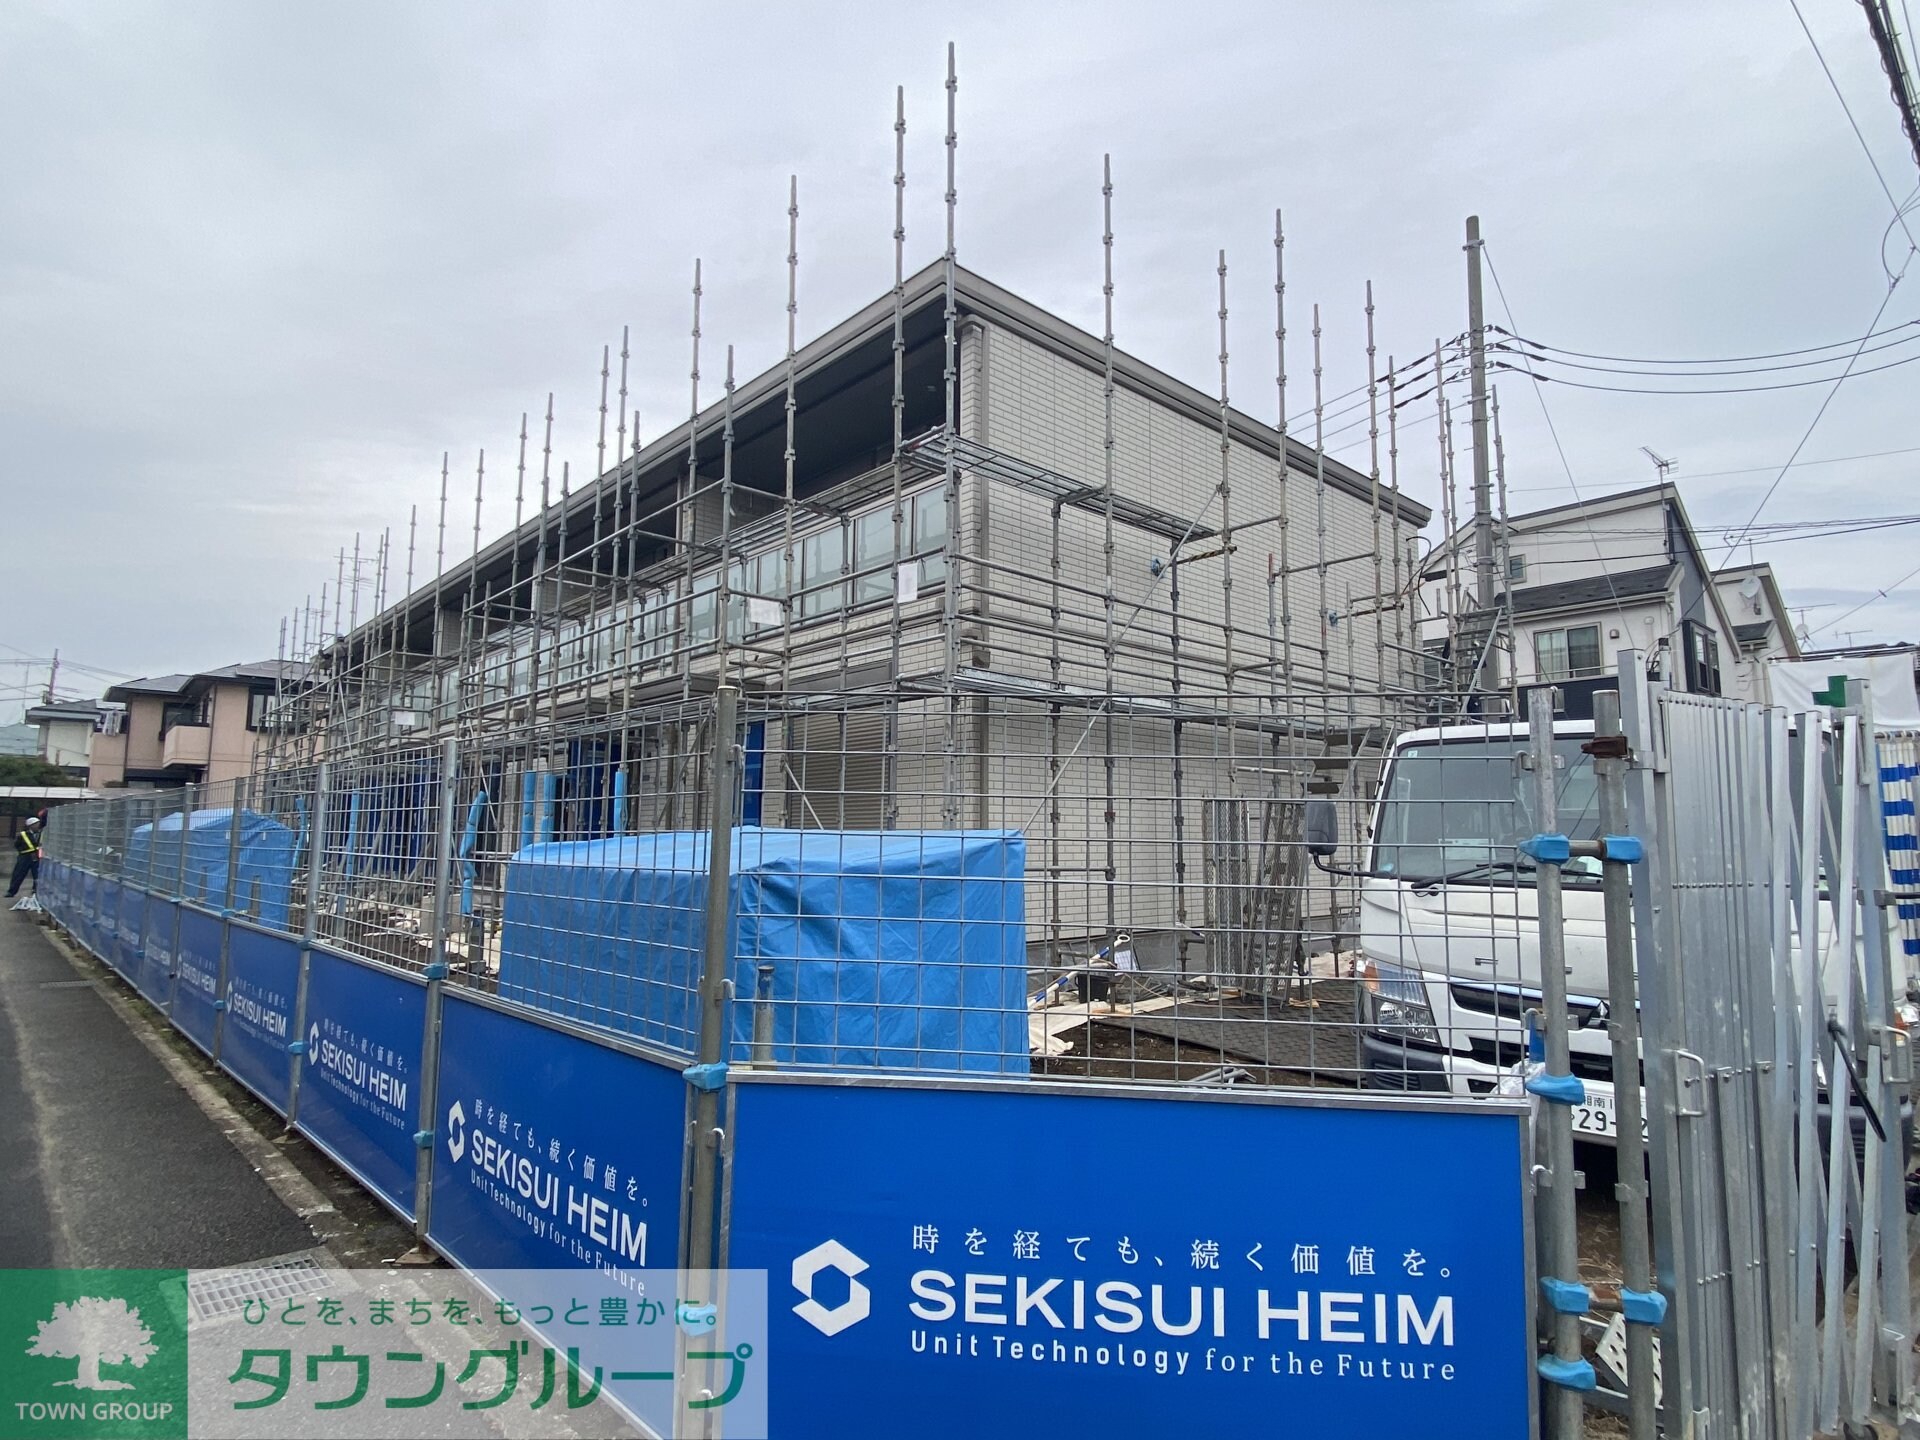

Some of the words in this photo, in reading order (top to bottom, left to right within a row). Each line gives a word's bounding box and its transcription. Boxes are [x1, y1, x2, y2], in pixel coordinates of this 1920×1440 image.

[233, 992, 262, 1025] SEKISUI
[262, 1008, 287, 1038] HEIM
[321, 1039, 366, 1089] SEKISUI
[369, 1066, 407, 1112] HEIM
[474, 1098, 648, 1208] 時を経ても、続く価値を。
[470, 1169, 488, 1193] Unit
[490, 1182, 546, 1239] Technology
[549, 1222, 567, 1249] for
[571, 1238, 592, 1264] the
[595, 1251, 645, 1296] Future
[471, 1129, 559, 1216] SEKISUI
[567, 1185, 648, 1267] HEIM
[911, 1224, 1452, 1278] 時を経ても、続く価値を。
[908, 1269, 1225, 1338] SEKISUI
[1258, 1289, 1454, 1346] HEIM
[910, 1330, 979, 1358] Unit
[993, 1337, 1190, 1375] Technology
[1204, 1348, 1255, 1373] for
[1270, 1352, 1323, 1376] the
[1338, 1355, 1455, 1381] Future
